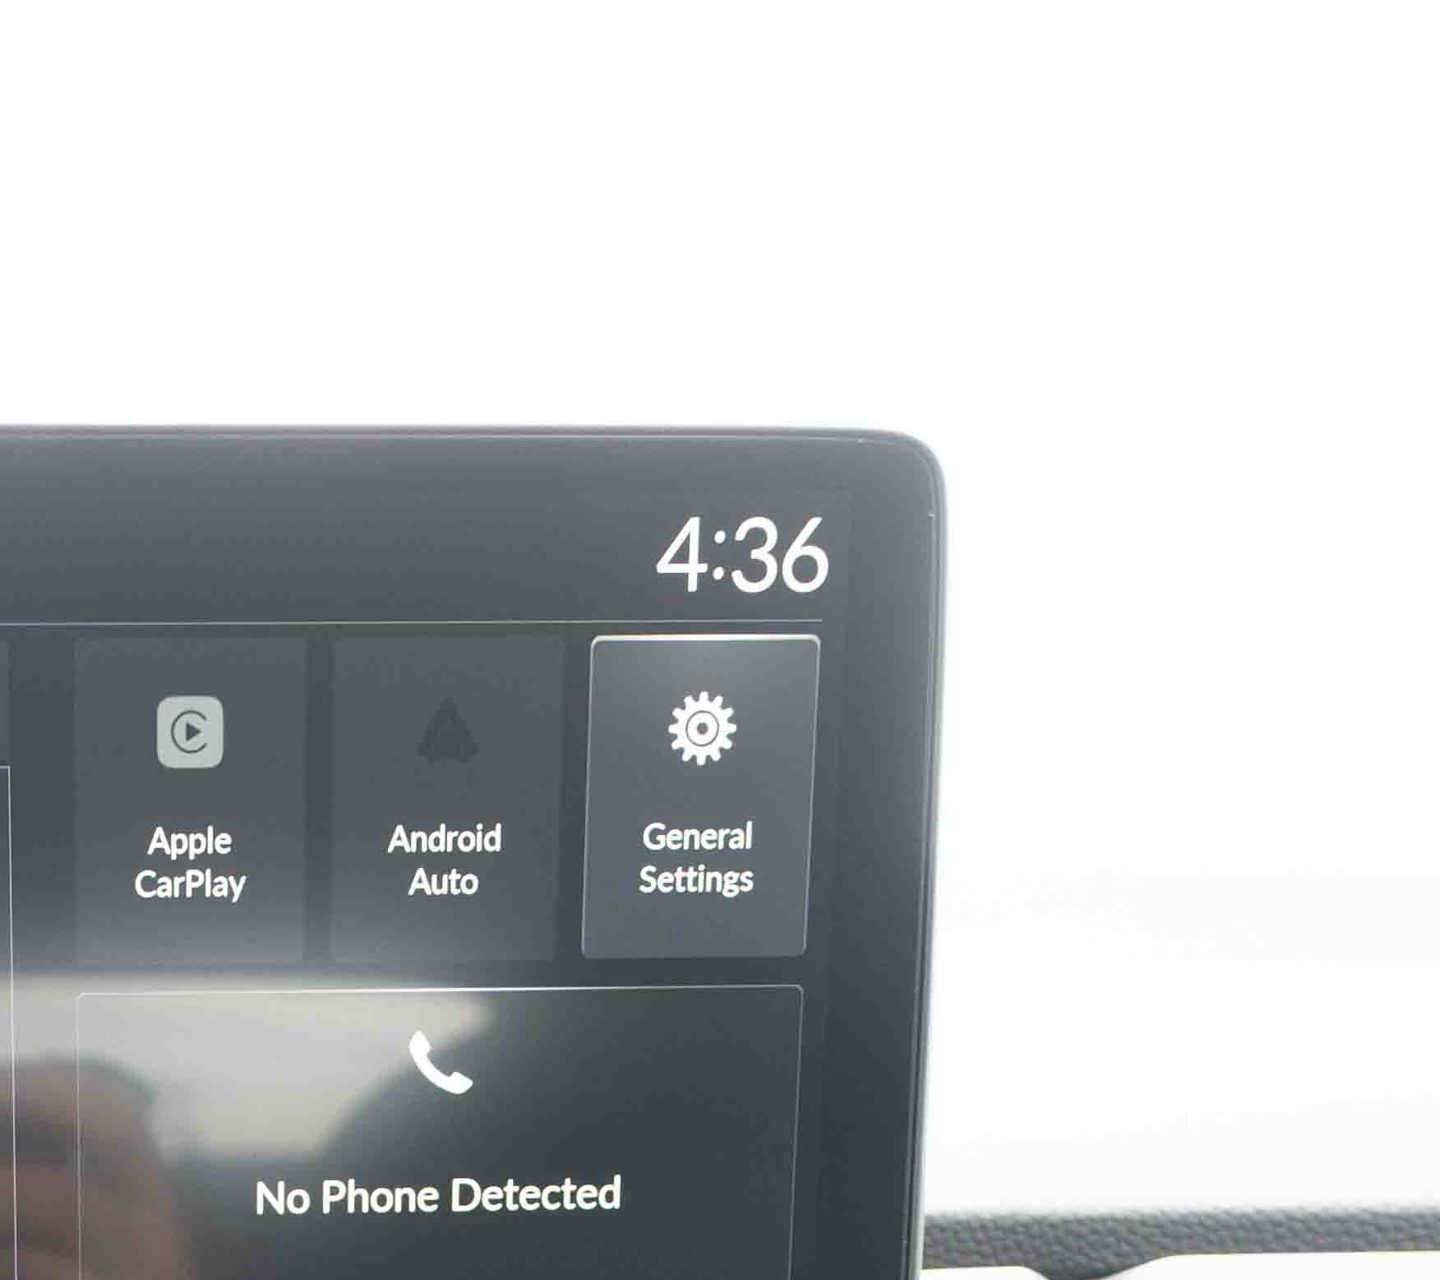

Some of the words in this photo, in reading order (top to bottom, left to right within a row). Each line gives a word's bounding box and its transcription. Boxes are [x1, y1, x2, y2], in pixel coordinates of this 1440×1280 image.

[655, 516, 829, 594] 4:36
[146, 824, 233, 861] Apple
[387, 822, 502, 855] Android
[642, 820, 753, 852] General
[134, 868, 247, 903] CarPlay
[407, 866, 479, 897] Auto
[639, 862, 754, 899] Settings
[255, 1180, 311, 1216] No
[322, 1177, 440, 1216] Phone
[451, 1174, 622, 1214] Detected
